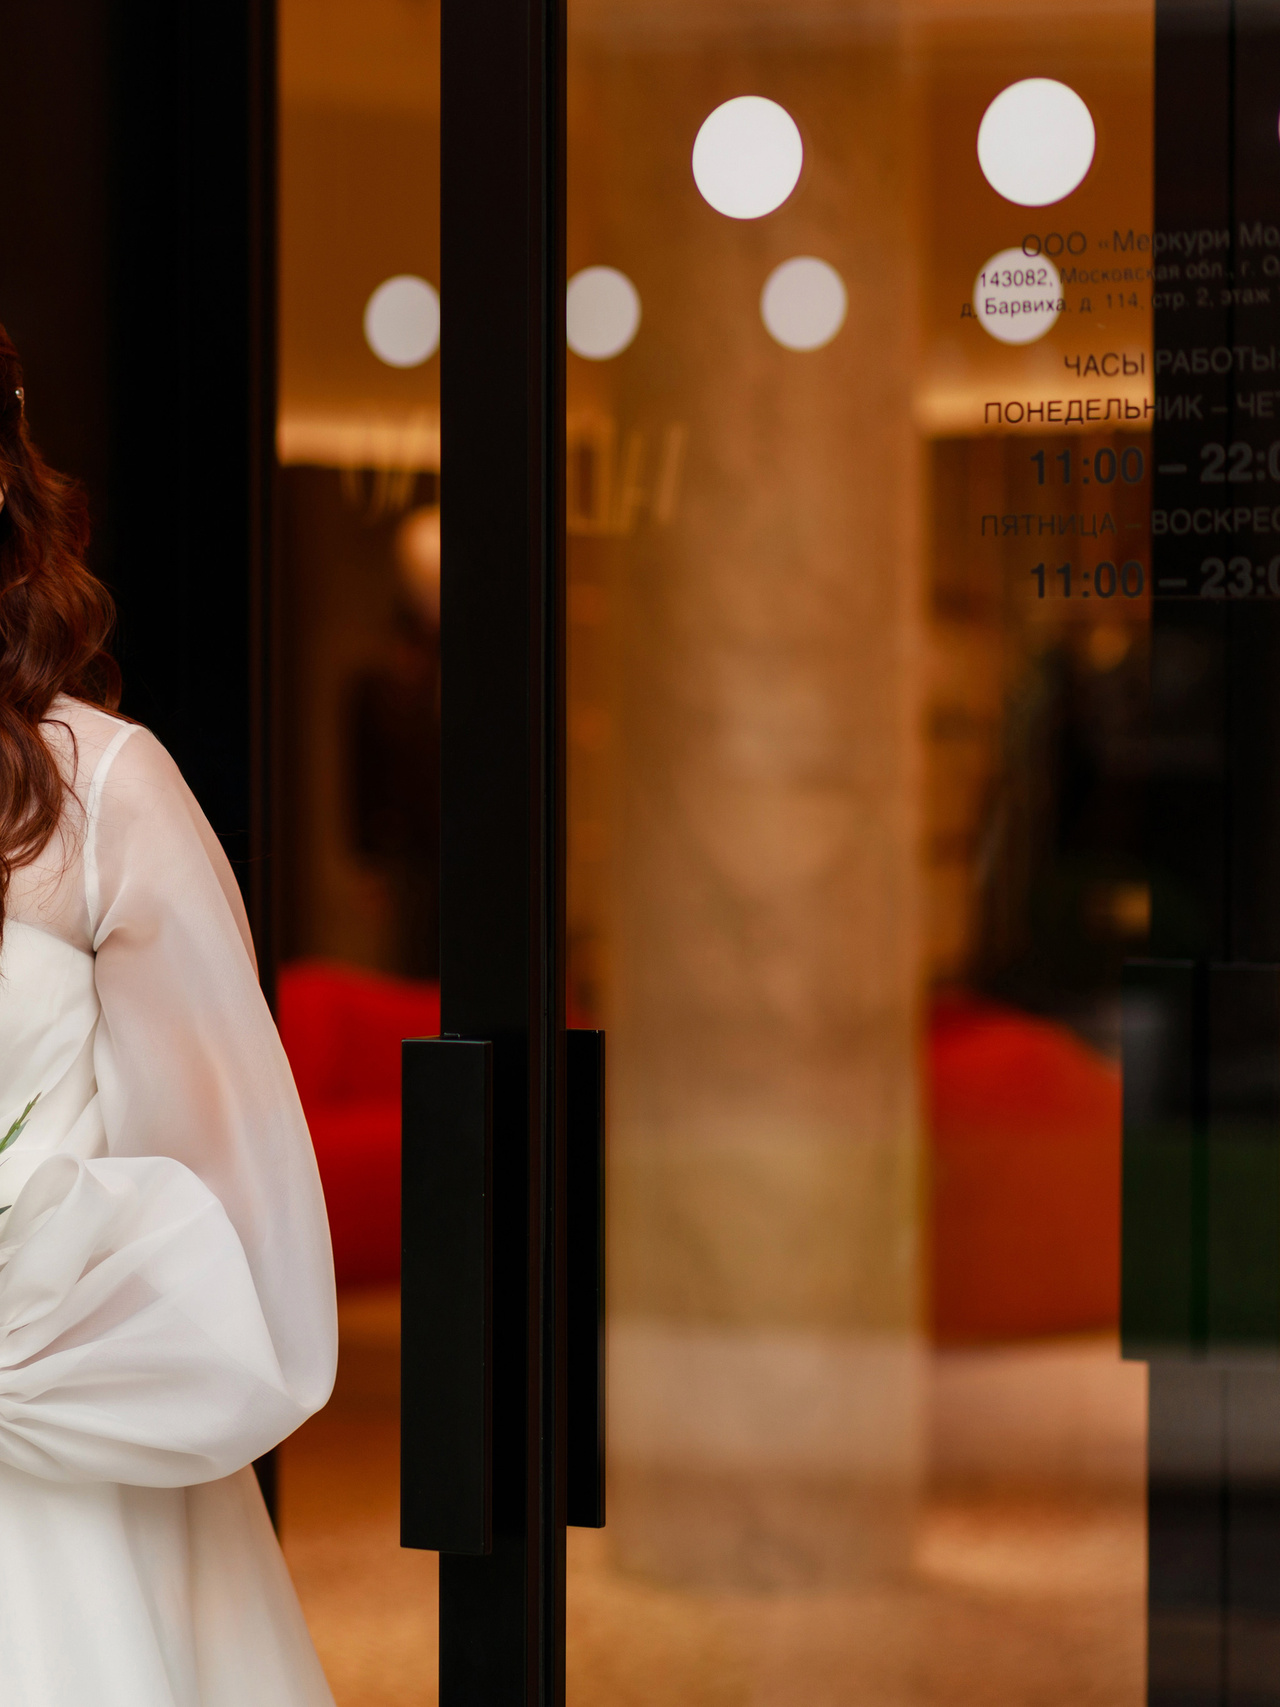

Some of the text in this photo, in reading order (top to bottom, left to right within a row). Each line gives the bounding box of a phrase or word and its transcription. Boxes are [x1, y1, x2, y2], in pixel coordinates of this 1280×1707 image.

[1021, 231, 1088, 258] ООО
[979, 268, 1054, 288] 143082,
[1064, 352, 1145, 377] ЧАСЫ
[984, 394, 1204, 425] ПОНЕДЕЛЬНИК
[1030, 446, 1145, 486] 11:00
[981, 512, 1118, 539] ПЯТНИЦА
[1030, 560, 1145, 599] 11:00
